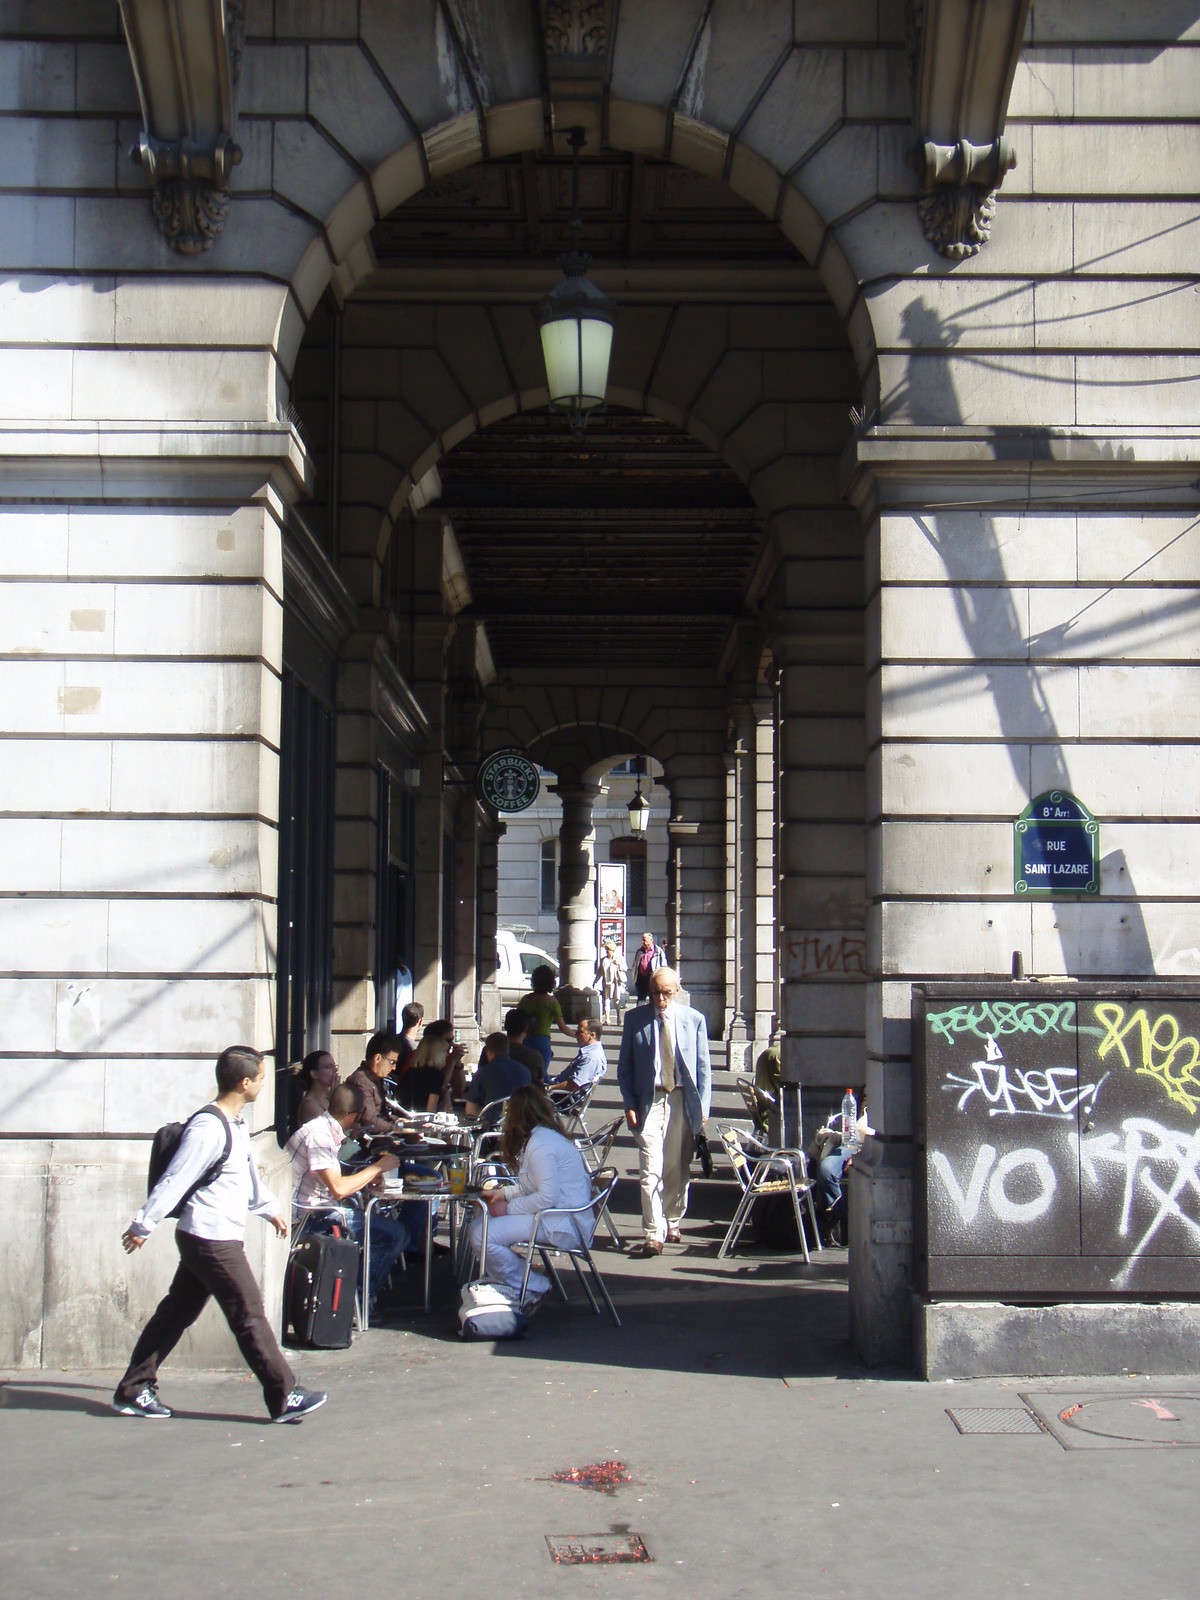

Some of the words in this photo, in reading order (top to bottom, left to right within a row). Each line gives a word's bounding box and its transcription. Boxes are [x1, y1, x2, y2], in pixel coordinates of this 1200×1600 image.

[486, 758, 535, 781] STARBUCKS
[491, 794, 528, 808] COFFEE
[1047, 841, 1066, 851] RUE
[1025, 864, 1051, 874] SAINT
[1053, 864, 1089, 874] LAZARE
